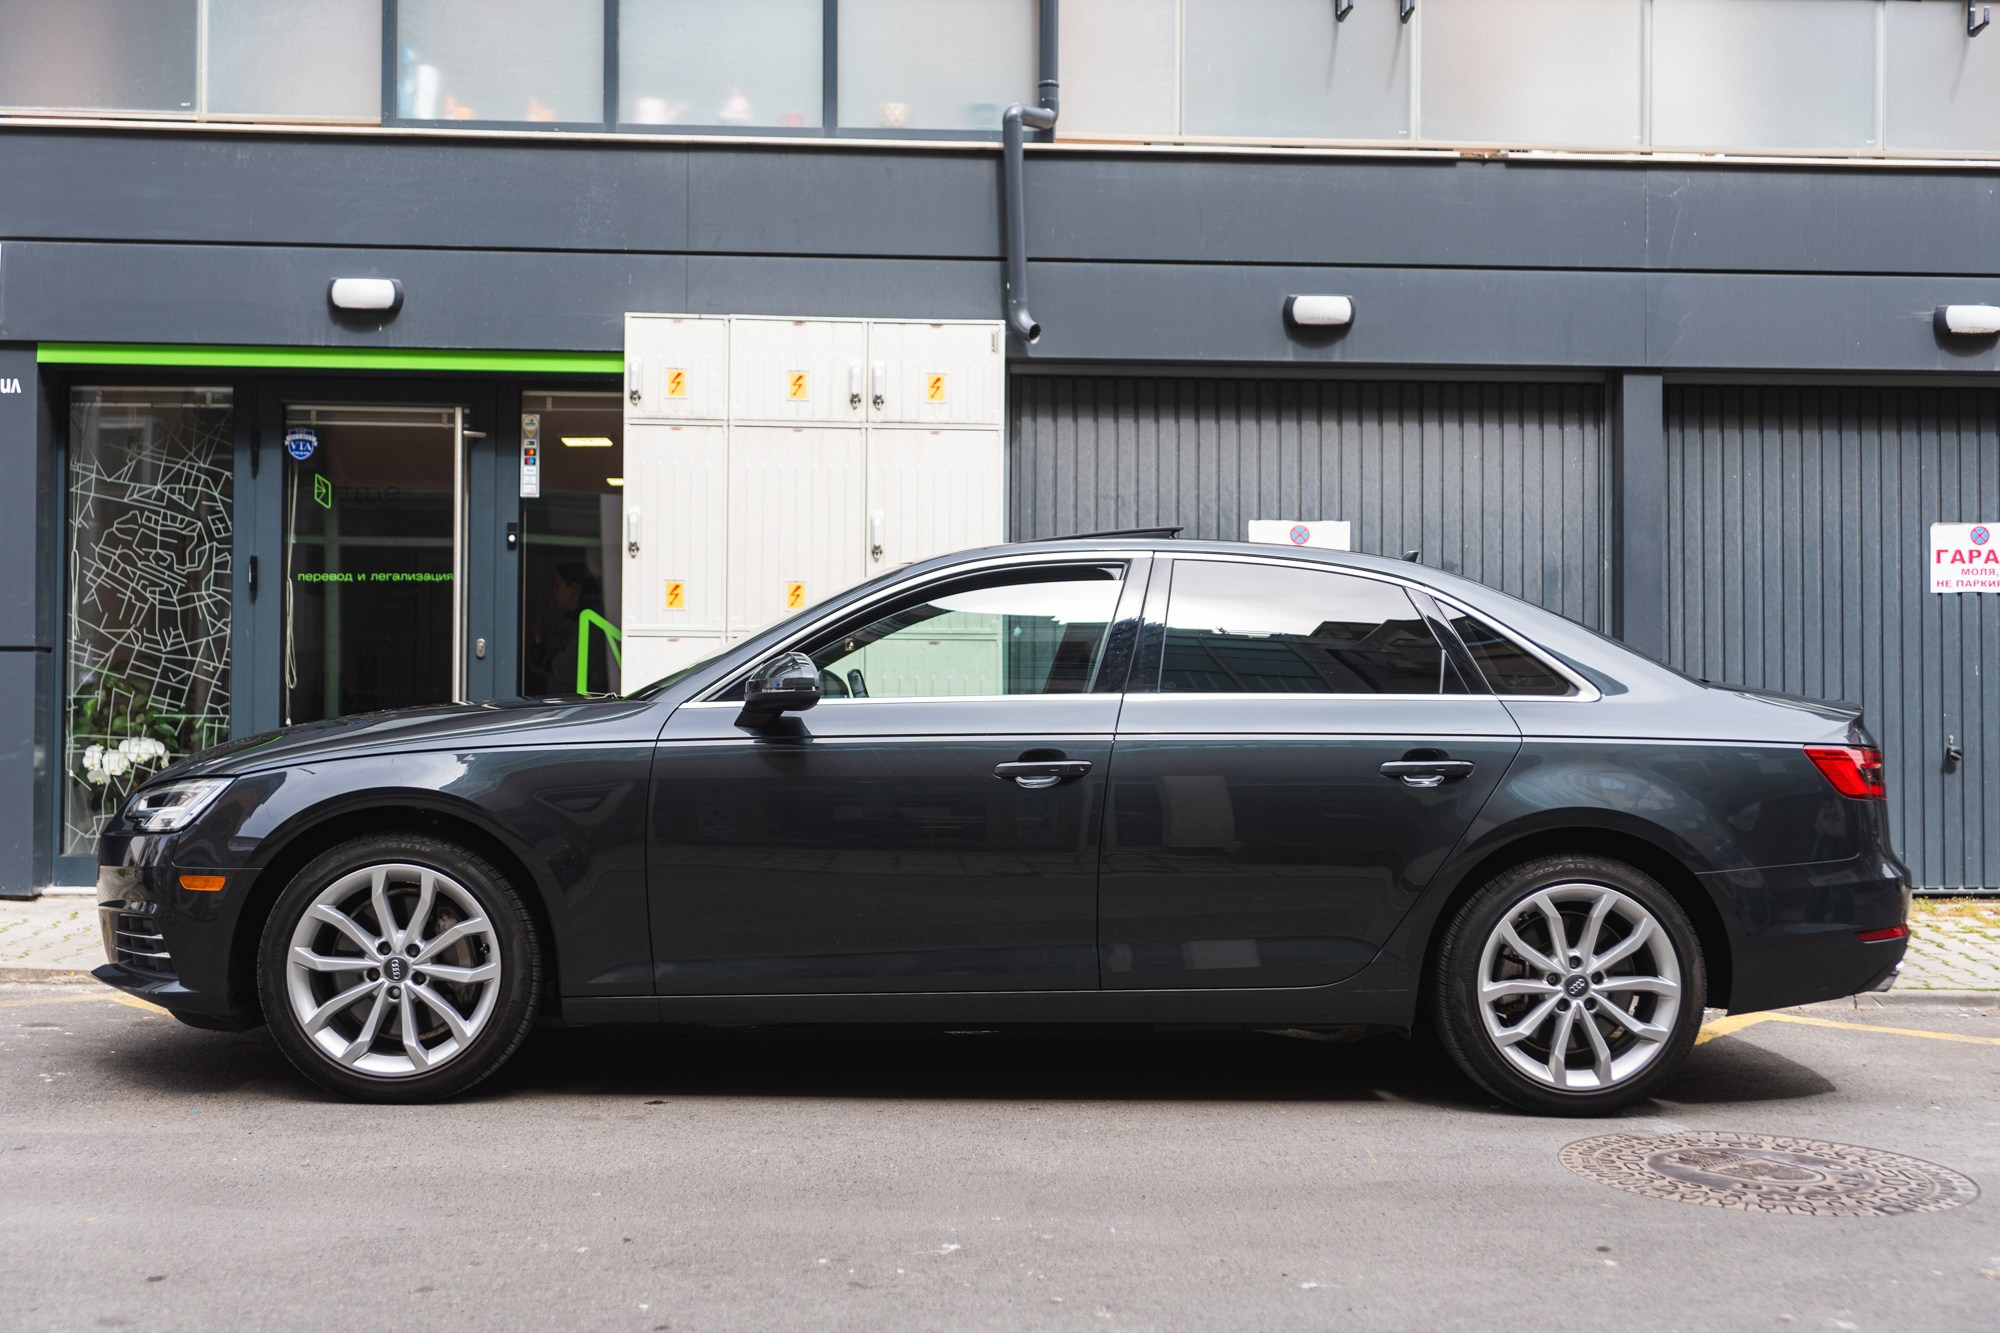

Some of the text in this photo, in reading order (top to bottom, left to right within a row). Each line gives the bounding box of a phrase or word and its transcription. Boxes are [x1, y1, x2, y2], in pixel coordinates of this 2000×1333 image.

[1936, 549, 2000, 564] ГАРА
[1961, 568, 1999, 577] МОЛЯ,
[297, 573, 454, 583] перевод и легализация
[1936, 580, 1952, 588] НЕ
